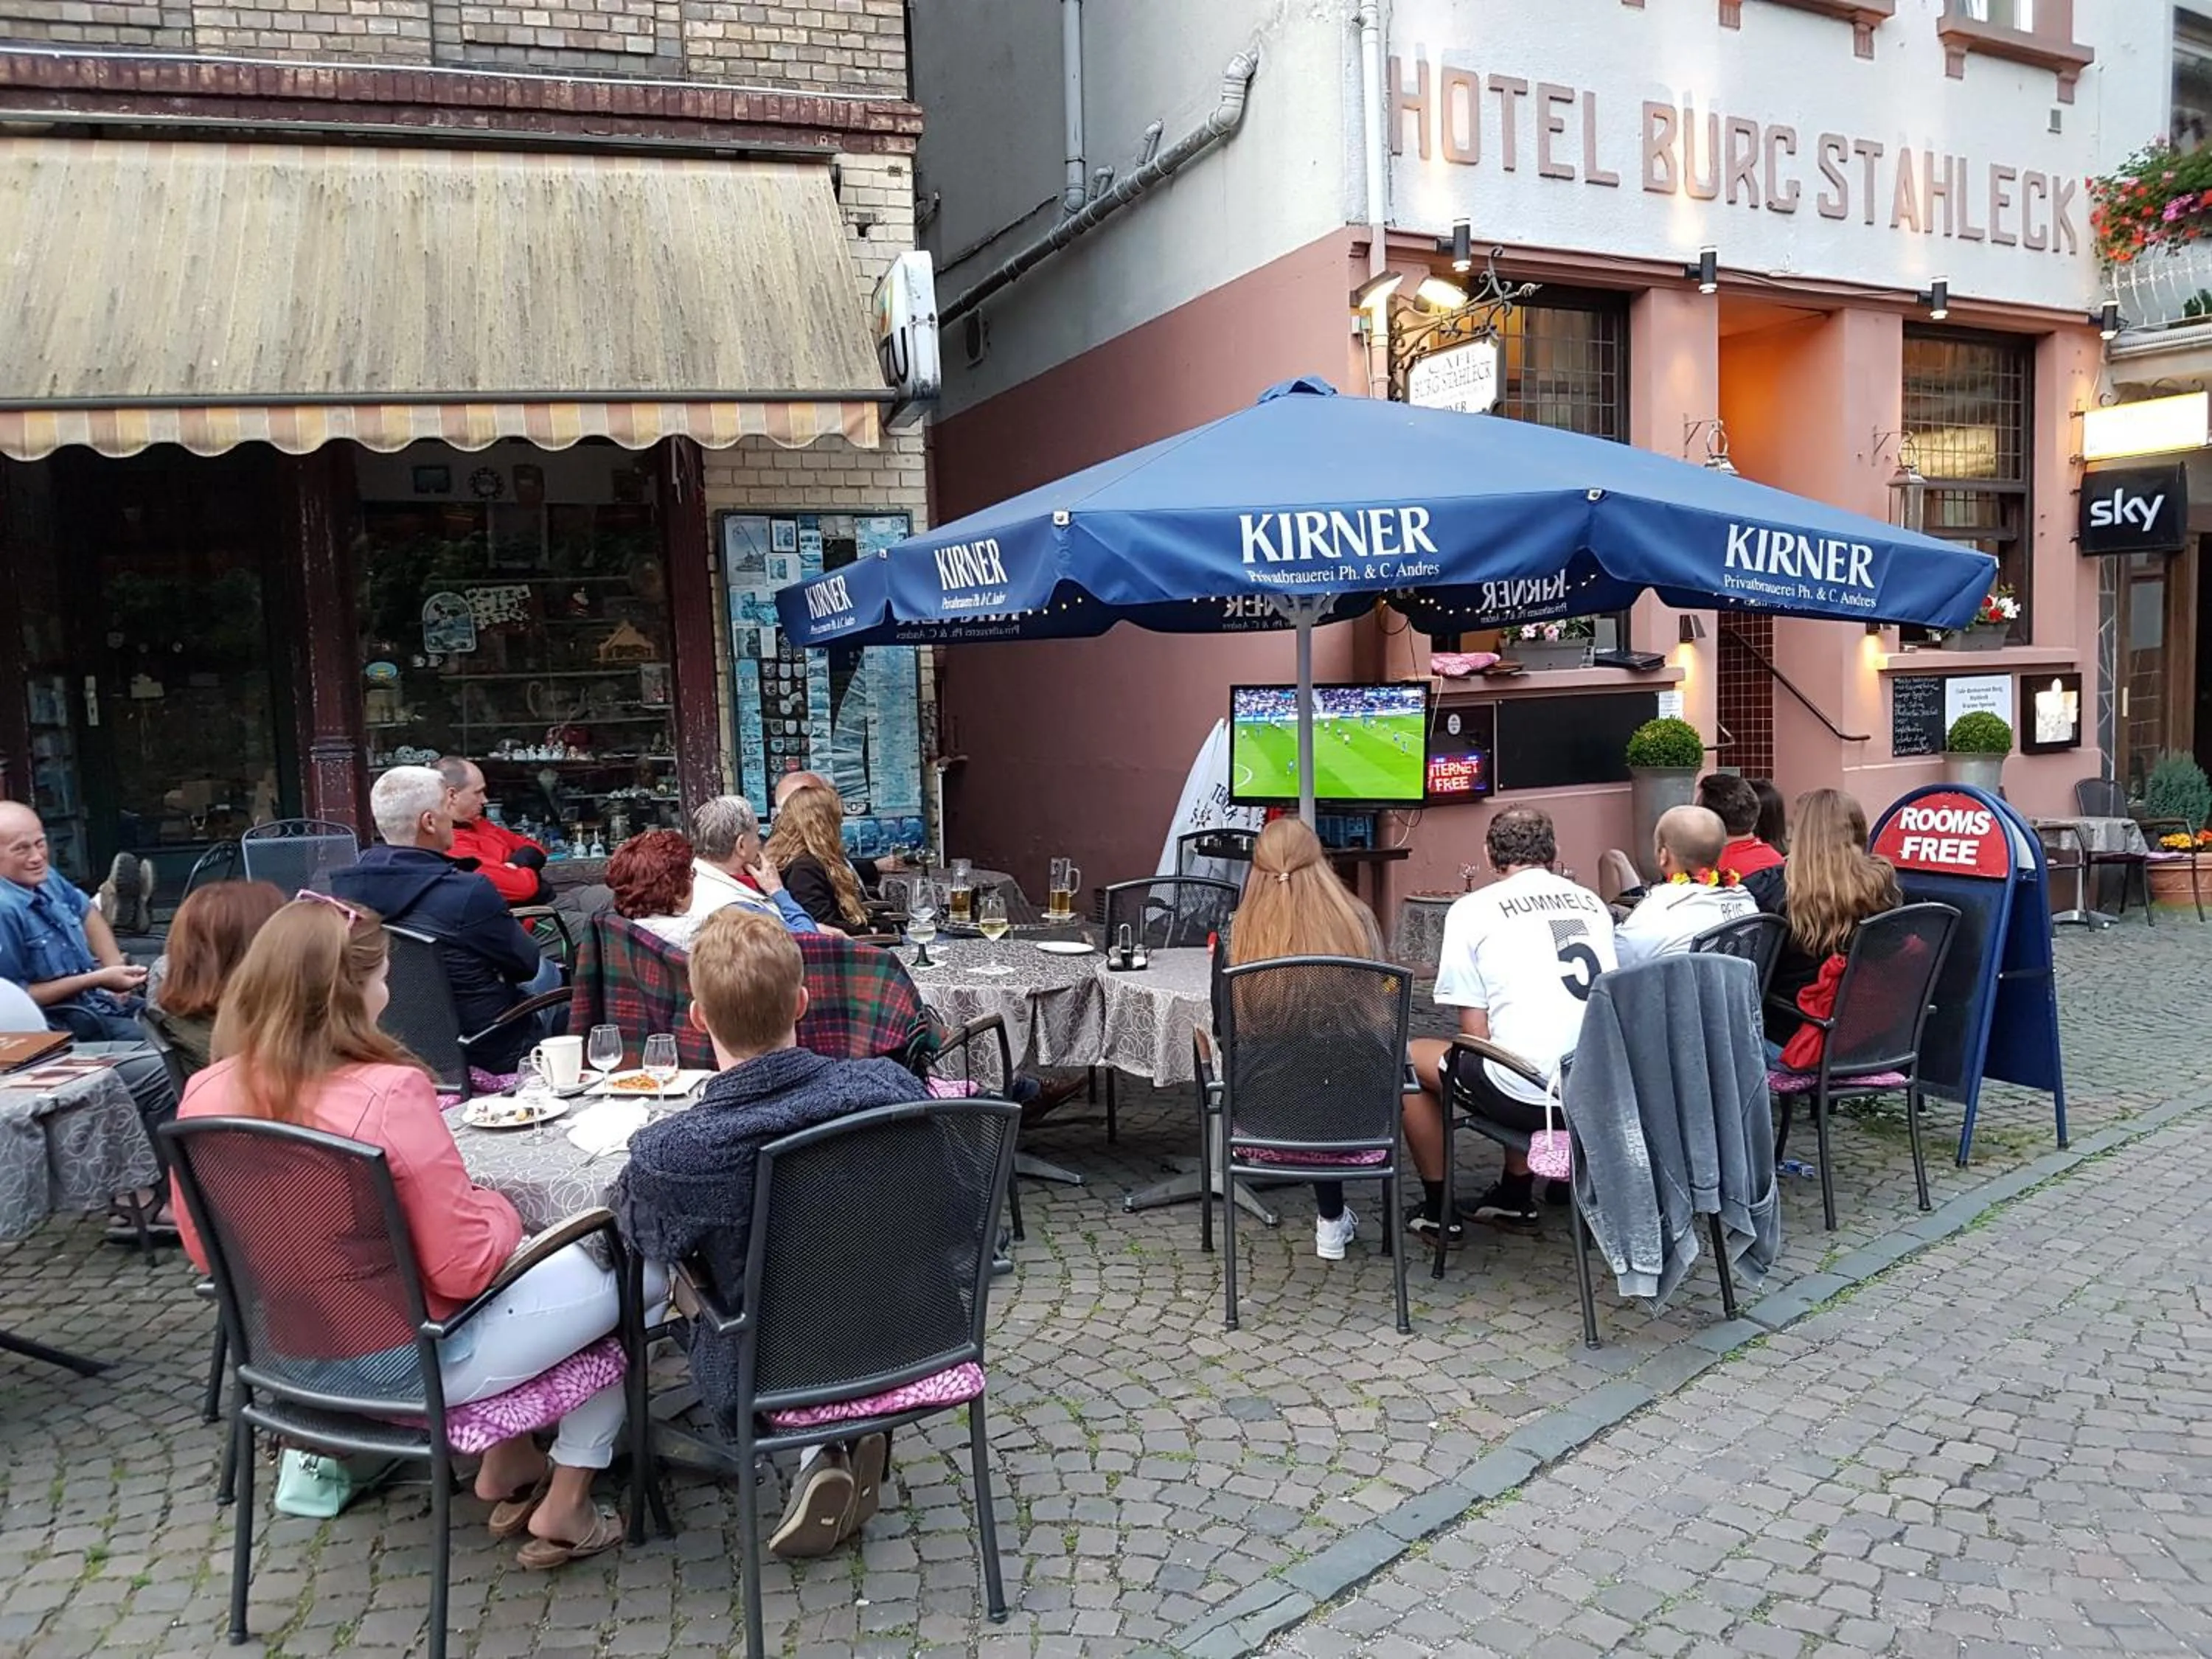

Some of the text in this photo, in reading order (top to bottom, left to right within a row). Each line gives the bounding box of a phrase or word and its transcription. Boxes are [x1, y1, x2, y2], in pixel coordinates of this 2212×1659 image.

[1389, 55, 2077, 255] HOTEL BURG STAHLECK
[2090, 487, 2165, 532] sky
[1239, 507, 1439, 564] KIRNER
[1724, 523, 1876, 589] KIRNER
[934, 538, 1009, 591] KIRNER
[1245, 561, 1440, 585] Privatbrauerei Ph. & C. Andres
[804, 575, 853, 620] KIRNER
[1723, 574, 1877, 608] Privatbrauerei Ph. & C. Andres
[1434, 776, 1470, 792] FREE
[1899, 807, 1991, 835] ROOMS
[1901, 835, 1980, 866] FREE
[1498, 893, 1599, 919] HUMMELS
[1548, 919, 1602, 1001] 5
